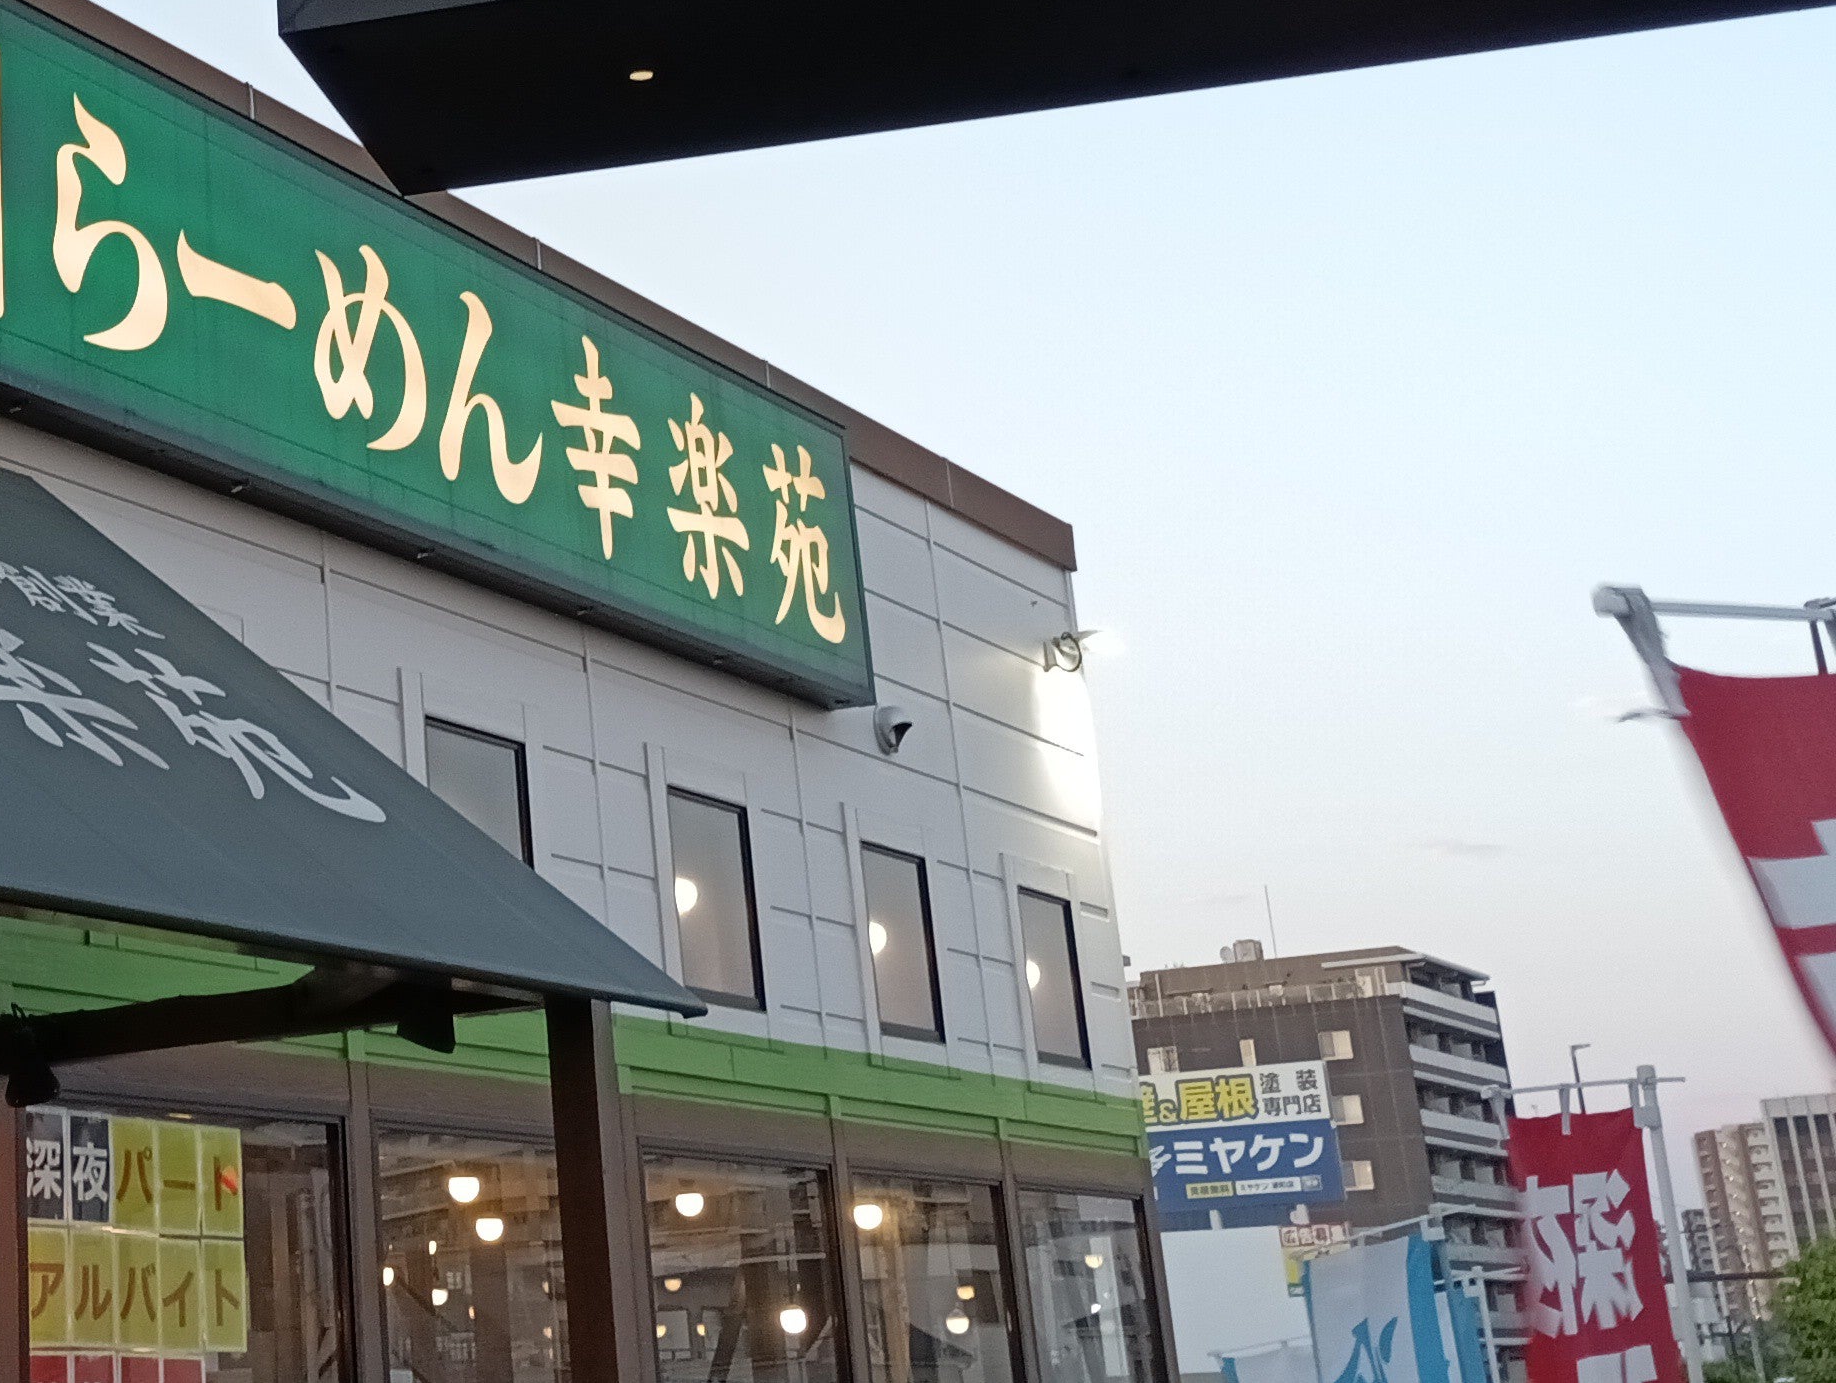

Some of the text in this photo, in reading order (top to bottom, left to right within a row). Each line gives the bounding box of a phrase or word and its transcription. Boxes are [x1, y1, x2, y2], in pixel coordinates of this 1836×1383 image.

[1263, 1093, 1322, 1117] 専門店
[1173, 1132, 1325, 1175] ミヤケン
[29, 1262, 241, 1328] アルバイト
